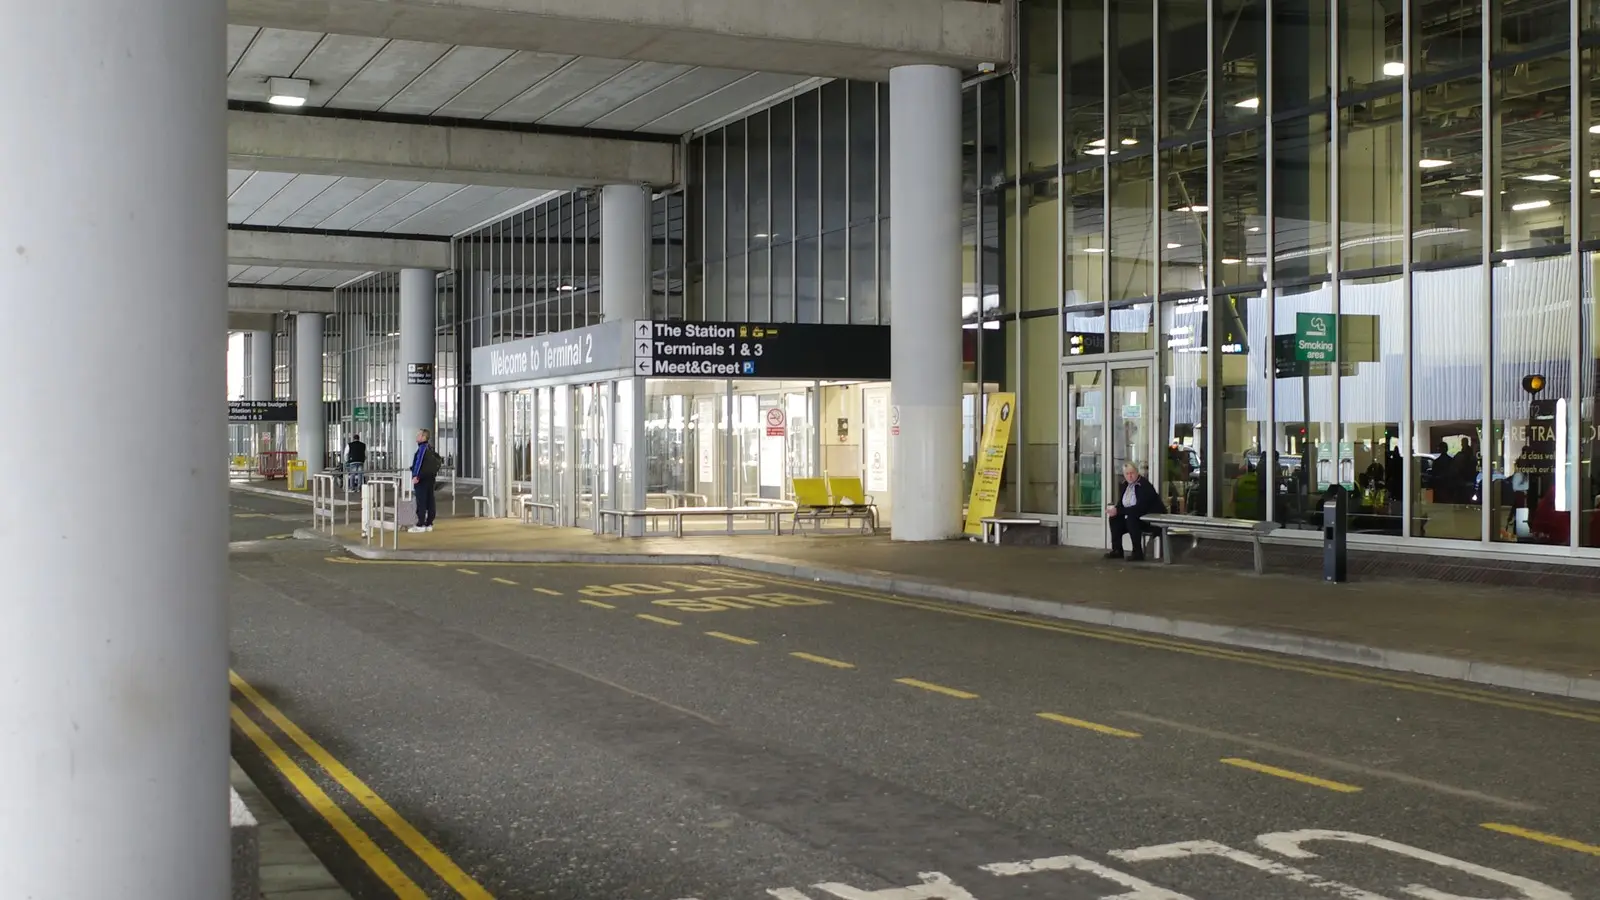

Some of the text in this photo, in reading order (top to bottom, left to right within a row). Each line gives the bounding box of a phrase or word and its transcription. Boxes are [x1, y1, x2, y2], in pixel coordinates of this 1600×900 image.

[655, 324, 735, 338] The Station
[655, 342, 763, 356] Terminals 1 & 3
[1299, 340, 1333, 352] Smoking
[490, 333, 592, 376] Welcome to Terminal 2
[655, 360, 740, 374] Meet&Greet
[650, 592, 834, 613] BUS
